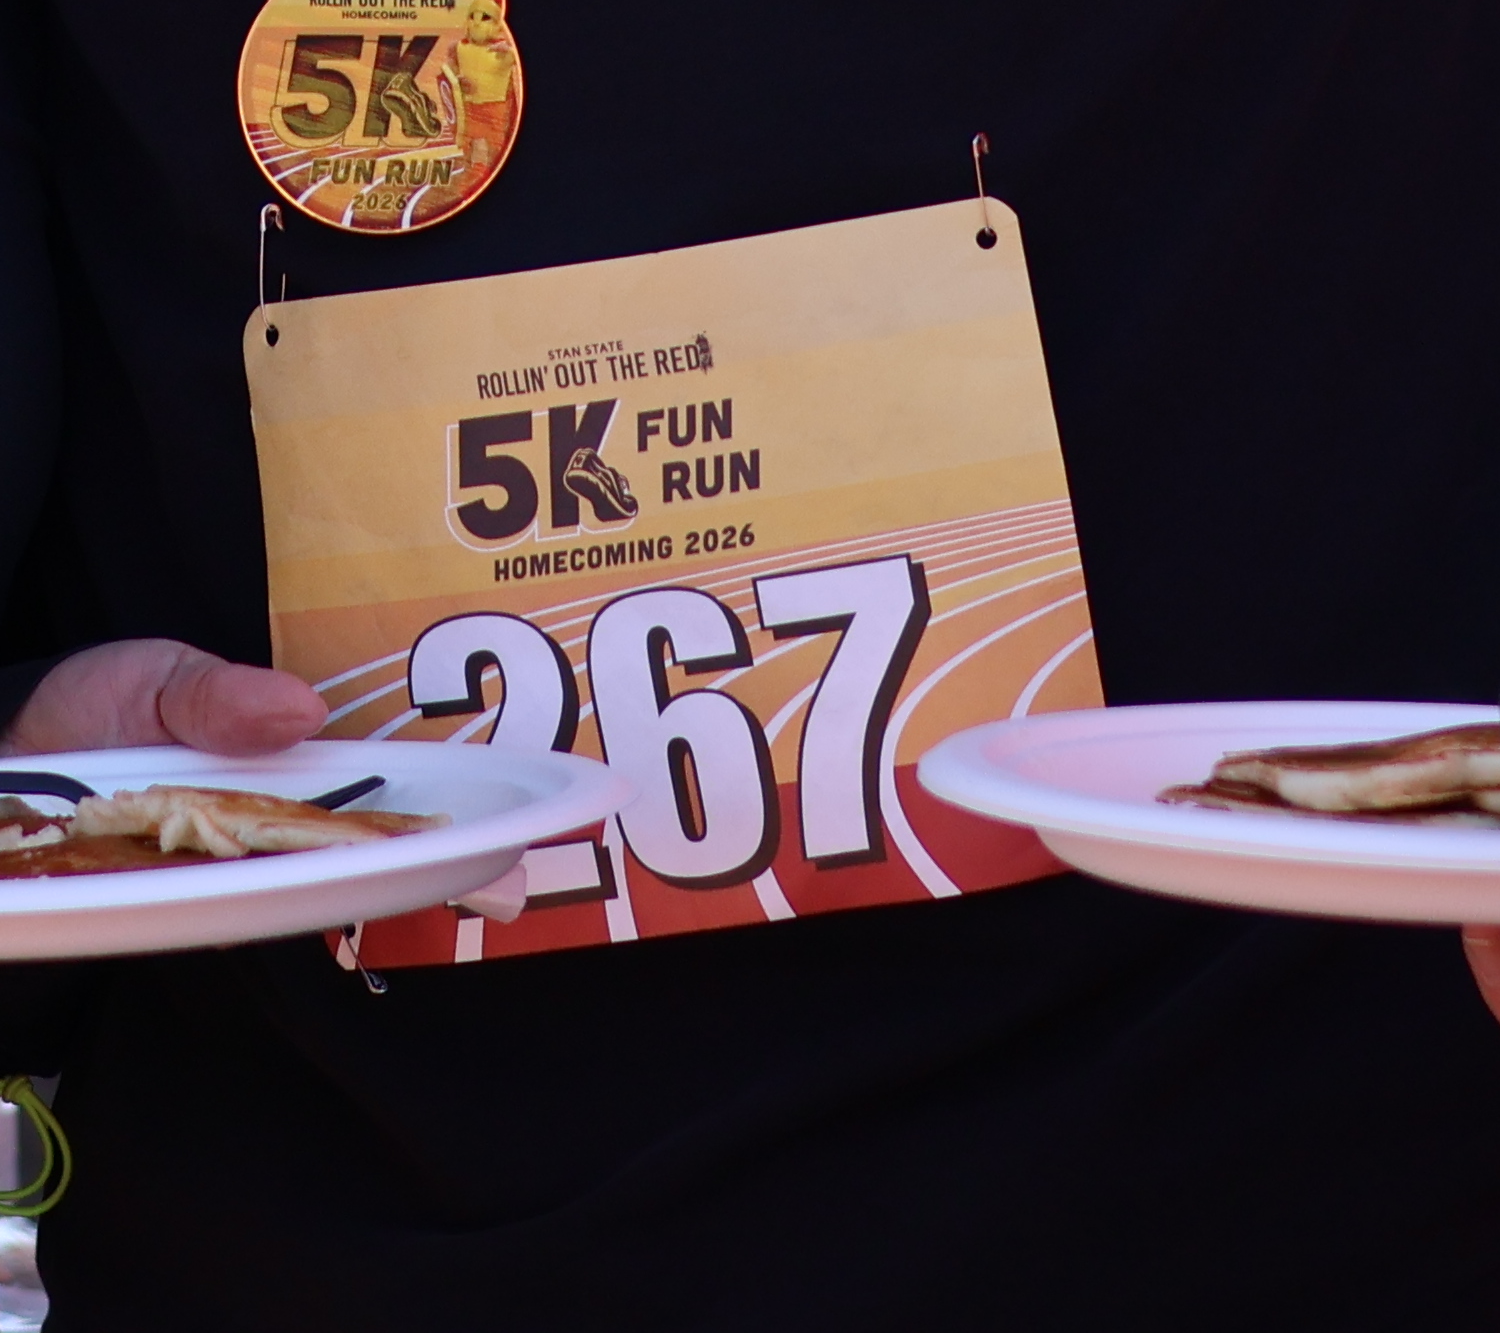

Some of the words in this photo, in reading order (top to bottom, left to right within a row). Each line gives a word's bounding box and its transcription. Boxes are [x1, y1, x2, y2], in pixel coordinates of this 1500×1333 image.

[341, 10, 418, 20] HOMECOMING
[274, 34, 442, 143] 5K
[310, 158, 377, 185] FUN
[384, 158, 453, 186] RUN
[351, 192, 408, 211] 2026
[476, 364, 548, 400] ROLLIN'
[554, 359, 599, 389] OUT
[606, 351, 649, 382] THE
[653, 343, 702, 375] RED
[547, 344, 582, 361] STAN
[584, 339, 624, 356] STATE
[449, 397, 639, 547] 5K
[636, 397, 733, 453] FUN
[661, 448, 761, 504] RUN
[494, 534, 674, 582] HOMECOMING
[684, 522, 756, 556] 2026
[407, 552, 932, 910] 267
